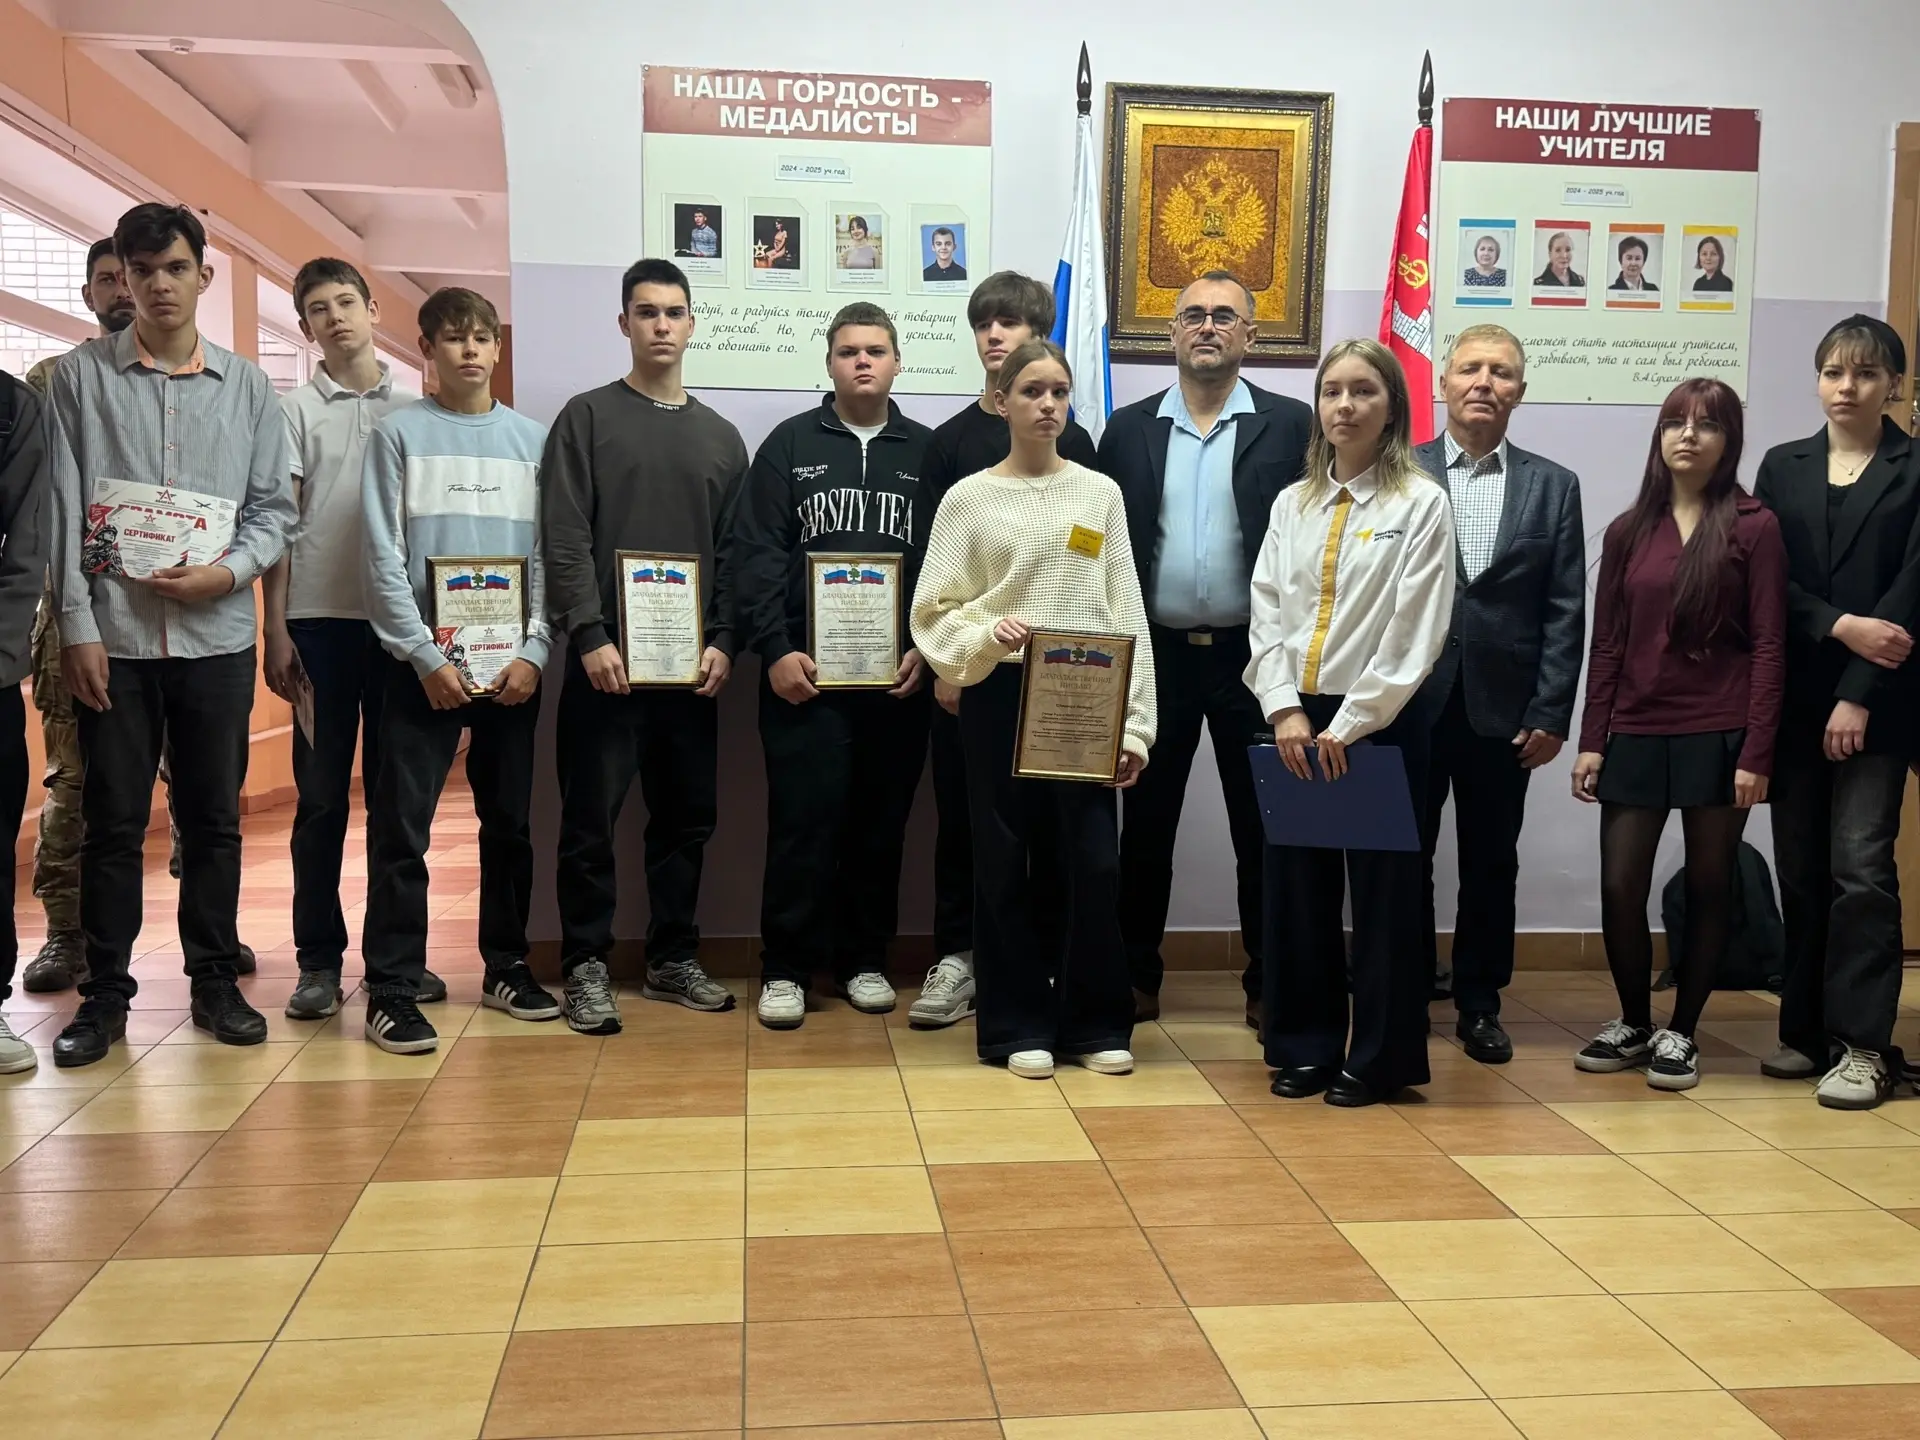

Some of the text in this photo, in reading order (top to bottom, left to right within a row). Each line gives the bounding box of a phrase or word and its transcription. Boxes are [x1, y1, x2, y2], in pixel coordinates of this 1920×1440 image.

[674, 74, 766, 99] НАША
[777, 78, 939, 108] ГОРДОСТЬ
[720, 105, 917, 136] МЕДАЛИСТЫ
[1495, 106, 1711, 136] НАШИ ЛУЧШИЕ
[1539, 136, 1666, 161] УЧИТЕЛЯ
[780, 164, 798, 172] 2024
[731, 307, 739, 316] а
[742, 304, 790, 322] радуйся
[796, 308, 833, 324] тому,
[904, 310, 957, 327] товарищ
[709, 321, 760, 338] успехов.
[777, 324, 795, 337] Но,
[903, 329, 956, 344] успехам,
[718, 336, 771, 352] обогнать
[777, 344, 798, 353] его.
[1522, 335, 1738, 354] сможет стать настоящим учителем,
[1533, 349, 1590, 368] забывает,
[1597, 354, 1617, 365] что
[1622, 356, 1630, 365] и
[1635, 356, 1657, 366] сам
[1662, 351, 1682, 366] был
[1685, 352, 1741, 371] ребенком.
[797, 487, 871, 544] VARSITY
[123, 527, 177, 543] СЕРТИФИКАТ
[469, 641, 513, 652] СЕРТИФИКАТ
